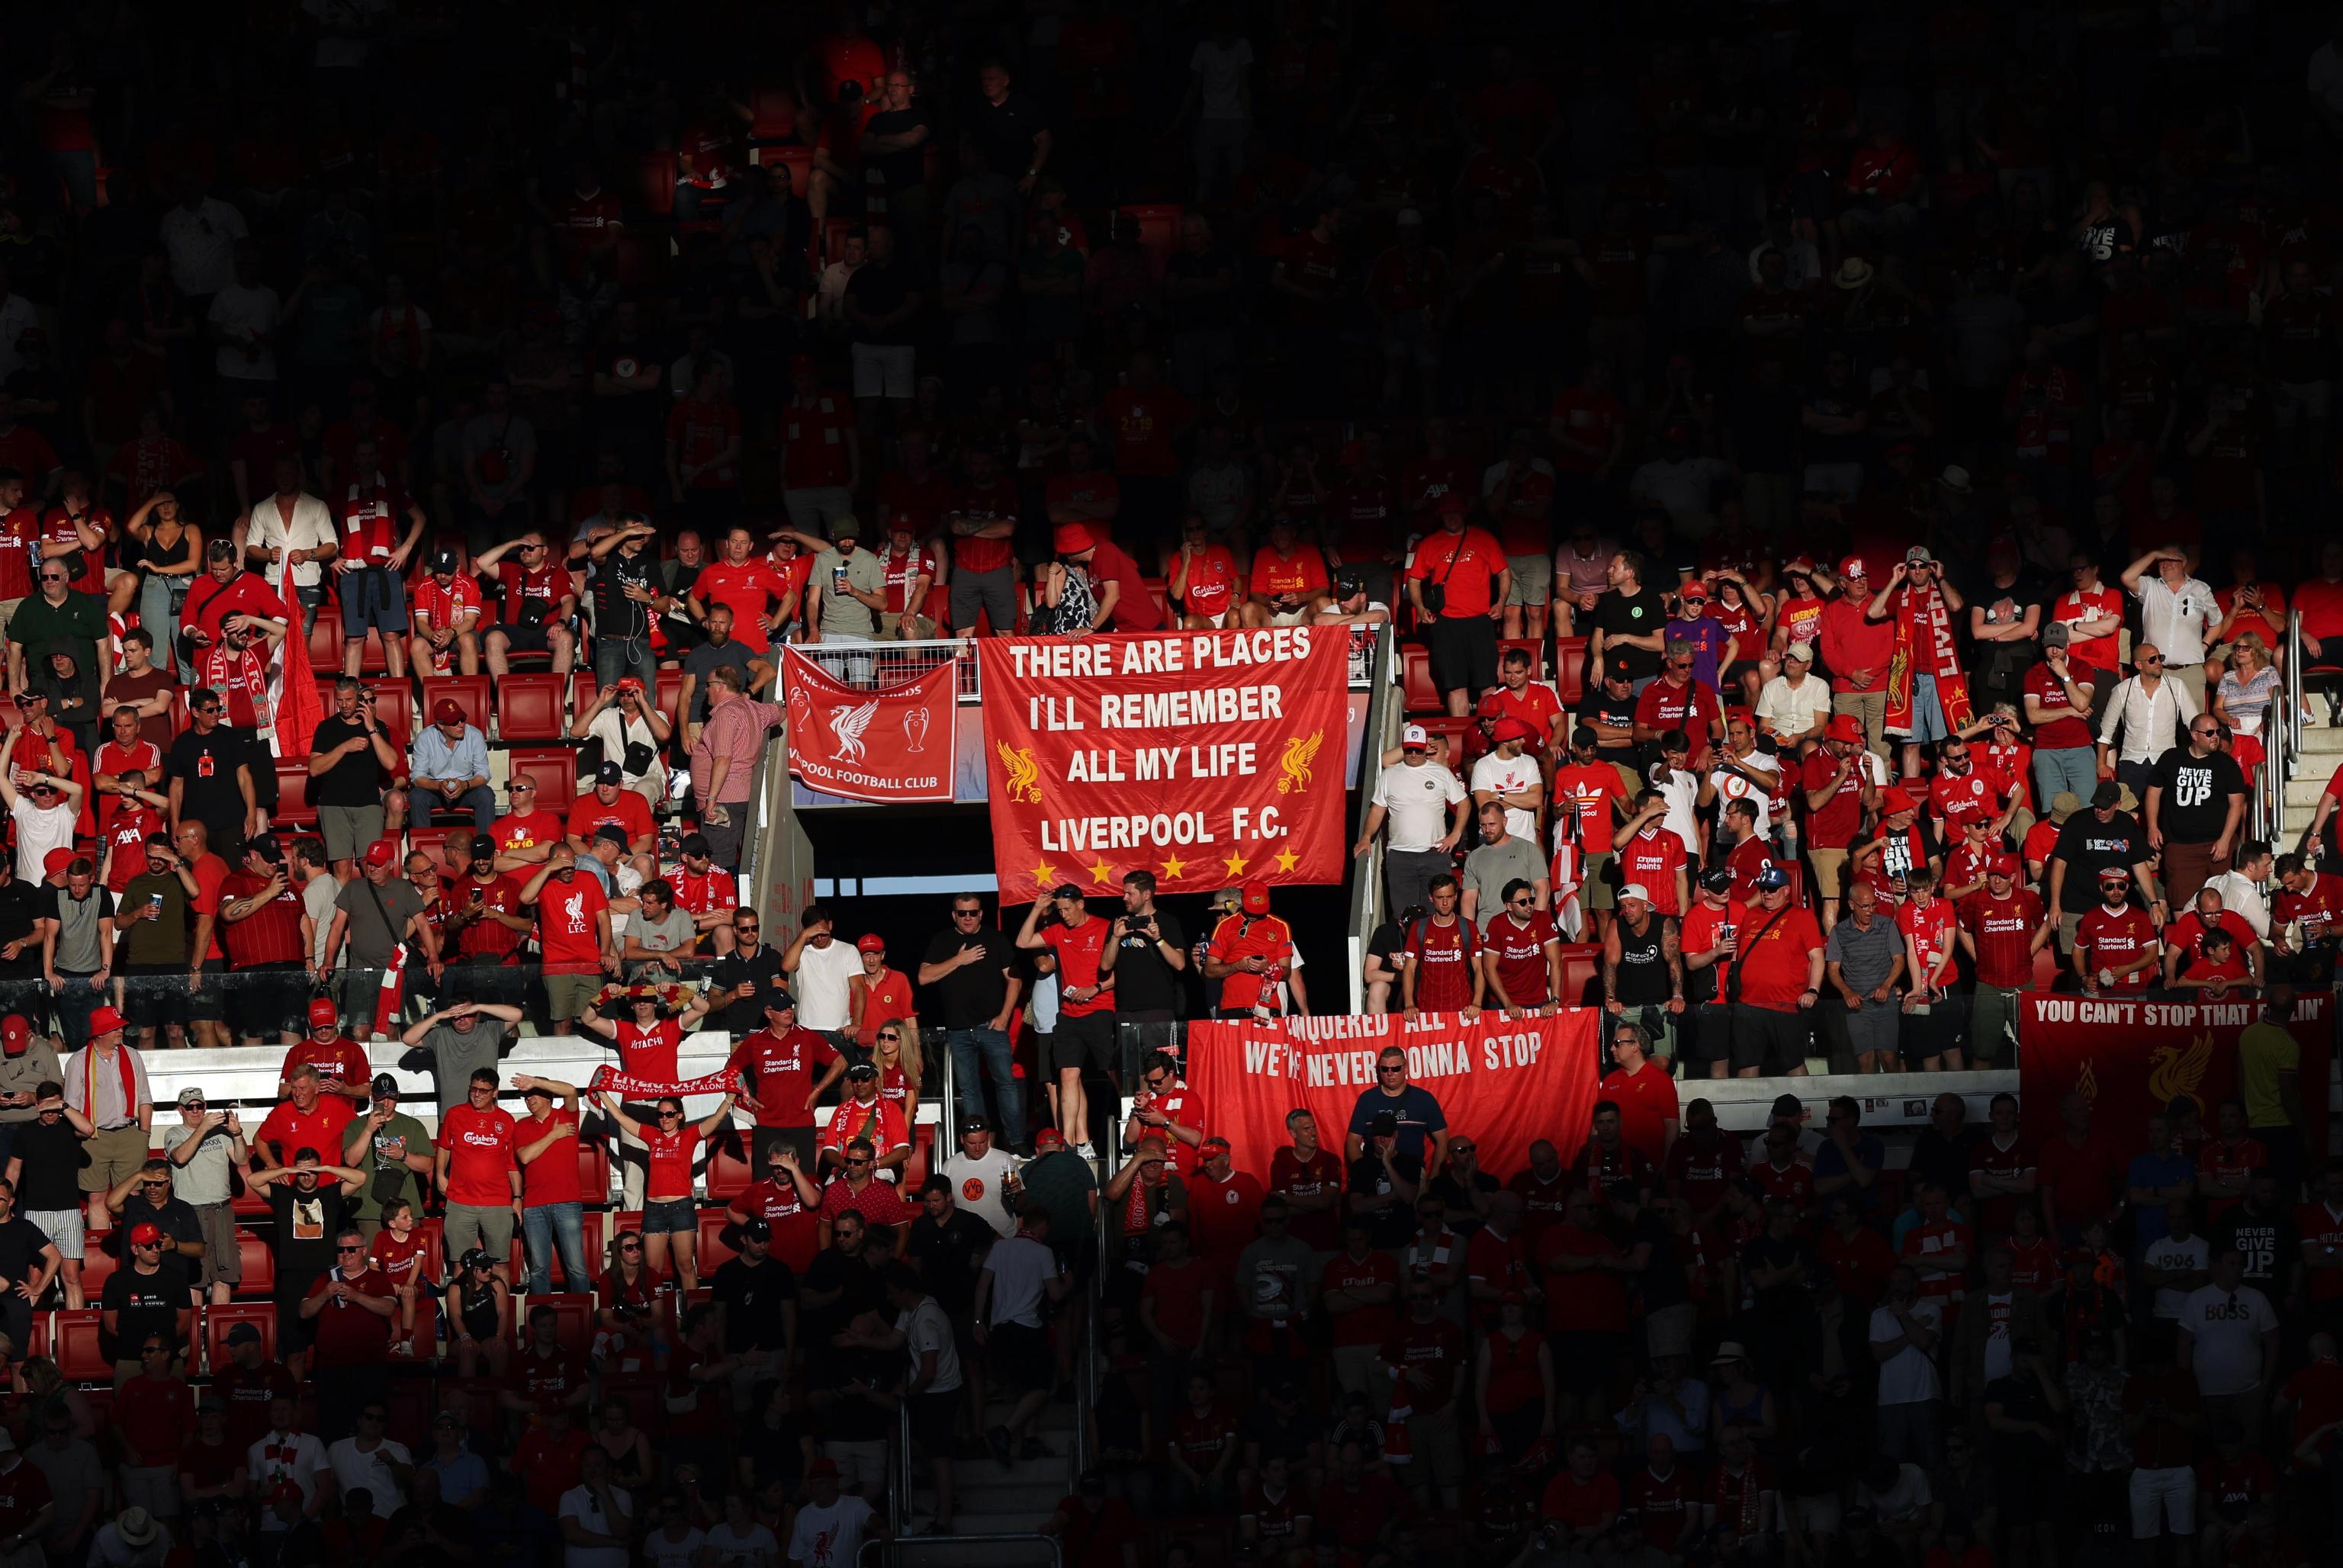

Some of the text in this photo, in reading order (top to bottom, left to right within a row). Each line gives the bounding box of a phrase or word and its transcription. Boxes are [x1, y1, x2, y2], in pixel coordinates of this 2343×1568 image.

[1193, 581, 1225, 597] Carlsberg
[1010, 627, 1311, 678] THERE ARE PLACES
[1030, 685, 1283, 731] I'LL REMEMBER
[1068, 743, 1256, 782] ALL MY LIFE
[2179, 766, 2212, 776] NEVER
[837, 770, 902, 789] FOOTBALL
[905, 776, 937, 789] CLUB
[2177, 775, 2212, 789] GIVE
[2177, 787, 2211, 806] UP
[1946, 797, 1978, 814] Carlsberg
[1041, 806, 1287, 851] LIVERPOOL F.C.
[115, 828, 142, 846] AXA
[1637, 863, 1662, 871] paints
[1504, 951, 1532, 959] Chartered
[1506, 946, 1532, 954] Standard
[2036, 1001, 2075, 1022] YOU
[2080, 1002, 2136, 1023] CAN'T
[2145, 1004, 2197, 1026] STOP
[2201, 1004, 2250, 1026] THAT
[630, 1037, 663, 1050] HITACHI
[765, 1059, 792, 1067] Standard
[1307, 1052, 1377, 1088] NEVER
[1405, 1041, 1471, 1080] ONNA
[1484, 1031, 1541, 1070] STOP
[763, 1065, 792, 1074] Chartered
[612, 1082, 639, 1092] YOU'LL
[699, 1081, 726, 1091] ALONE
[464, 1133, 498, 1146] Carlsberg
[764, 1210, 792, 1219] Chartered
[766, 1203, 792, 1212] Standard
[2235, 1226, 2274, 1238] NEVER
[2319, 1232, 2343, 1244] HITAC
[2235, 1237, 2274, 1251] GIVE
[2205, 1303, 2249, 1321] BOSS
